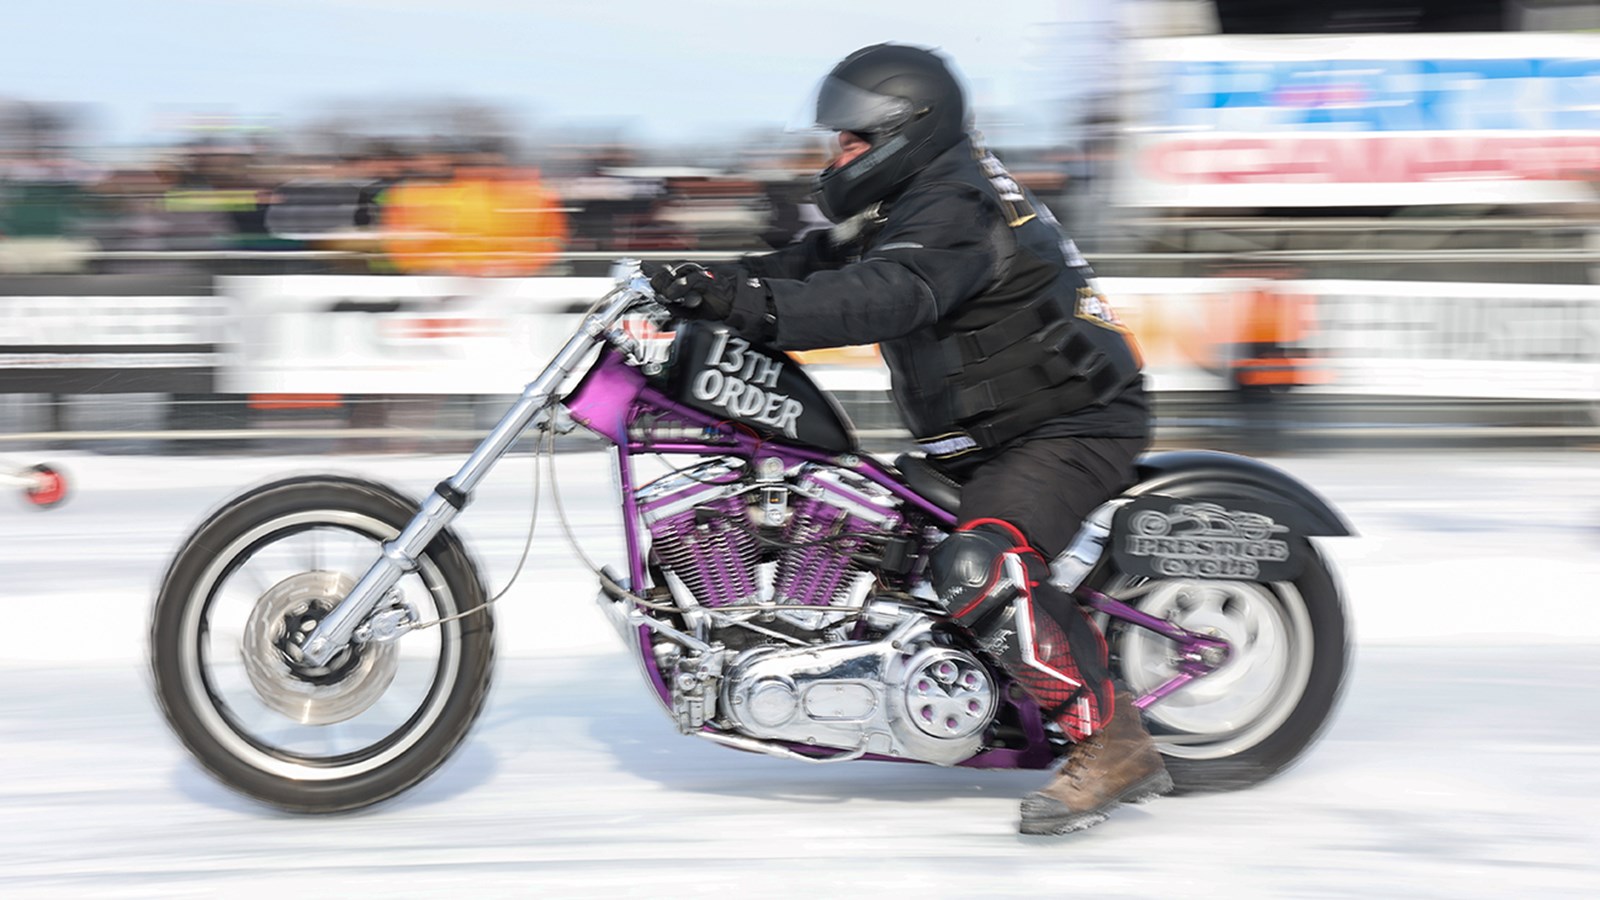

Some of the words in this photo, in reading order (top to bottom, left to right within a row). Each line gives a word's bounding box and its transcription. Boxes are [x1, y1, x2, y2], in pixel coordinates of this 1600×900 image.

[706, 330, 784, 388] 13TH
[694, 370, 804, 439] ORDER
[1127, 534, 1290, 561] PRESTIGE
[1156, 557, 1260, 580] CYCLE
